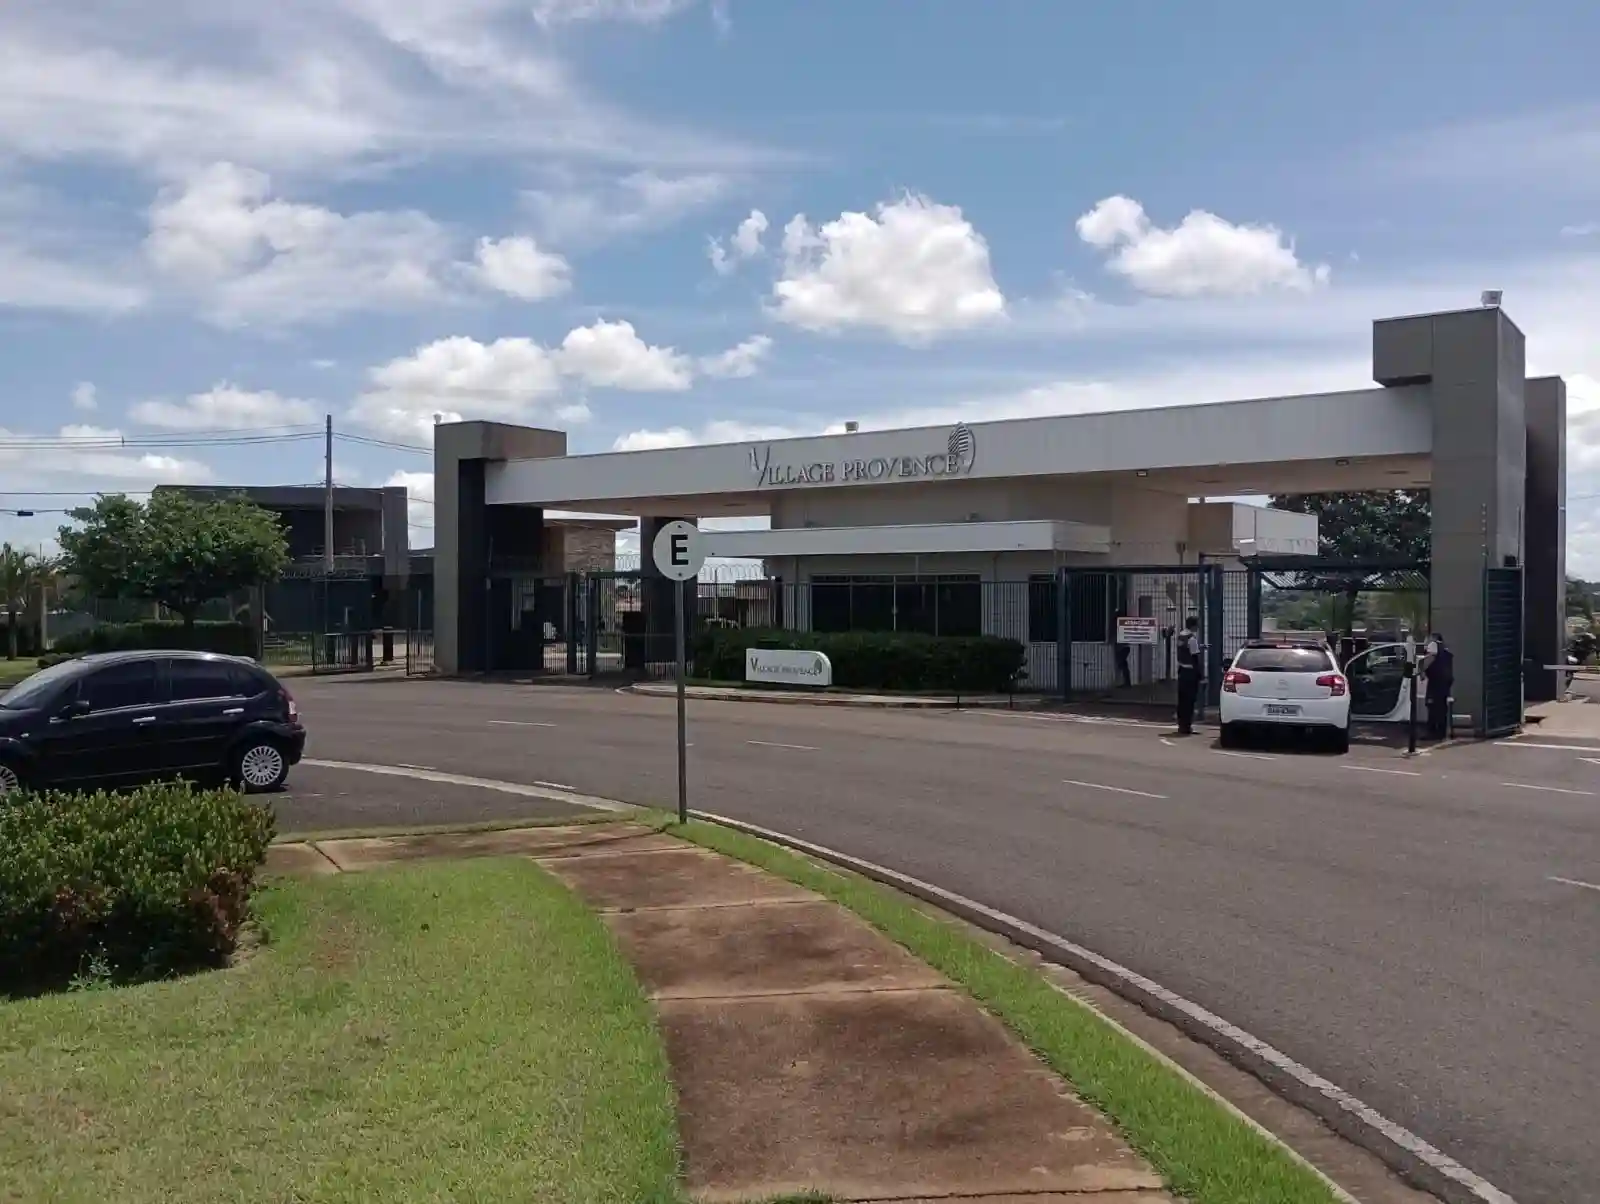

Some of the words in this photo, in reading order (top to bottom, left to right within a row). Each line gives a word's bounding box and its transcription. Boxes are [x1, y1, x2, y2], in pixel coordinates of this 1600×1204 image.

[748, 445, 836, 488] VILLAGE
[840, 453, 960, 481] PROVENCE
[671, 534, 689, 566] E
